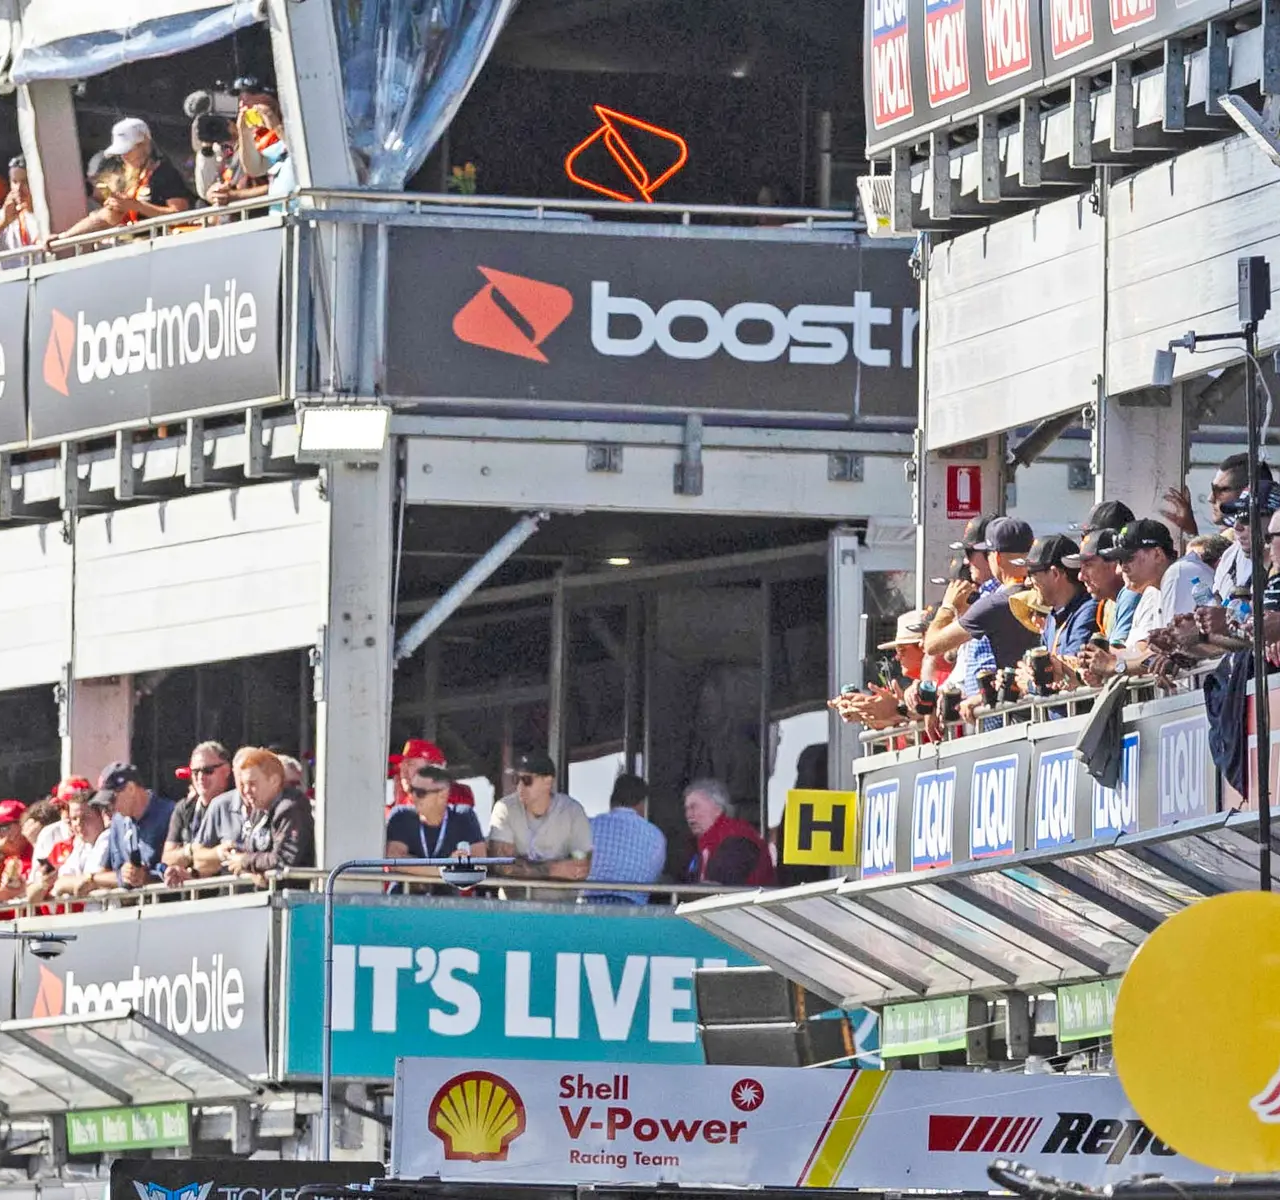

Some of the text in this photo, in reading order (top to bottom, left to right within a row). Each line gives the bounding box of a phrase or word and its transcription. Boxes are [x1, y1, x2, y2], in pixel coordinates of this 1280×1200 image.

[873, 34, 910, 126] MOLY
[925, 14, 969, 96] MOLY
[77, 279, 257, 384] boostmobile
[798, 803, 846, 852] H
[864, 790, 895, 868] LIQUI
[913, 774, 953, 860] LIQUI
[972, 764, 1016, 849] LIQUI
[1038, 761, 1076, 842] LIQUI
[559, 1074, 630, 1102] Shell
[559, 1106, 748, 1145] V-Power
[569, 1149, 680, 1168] Racing Team
